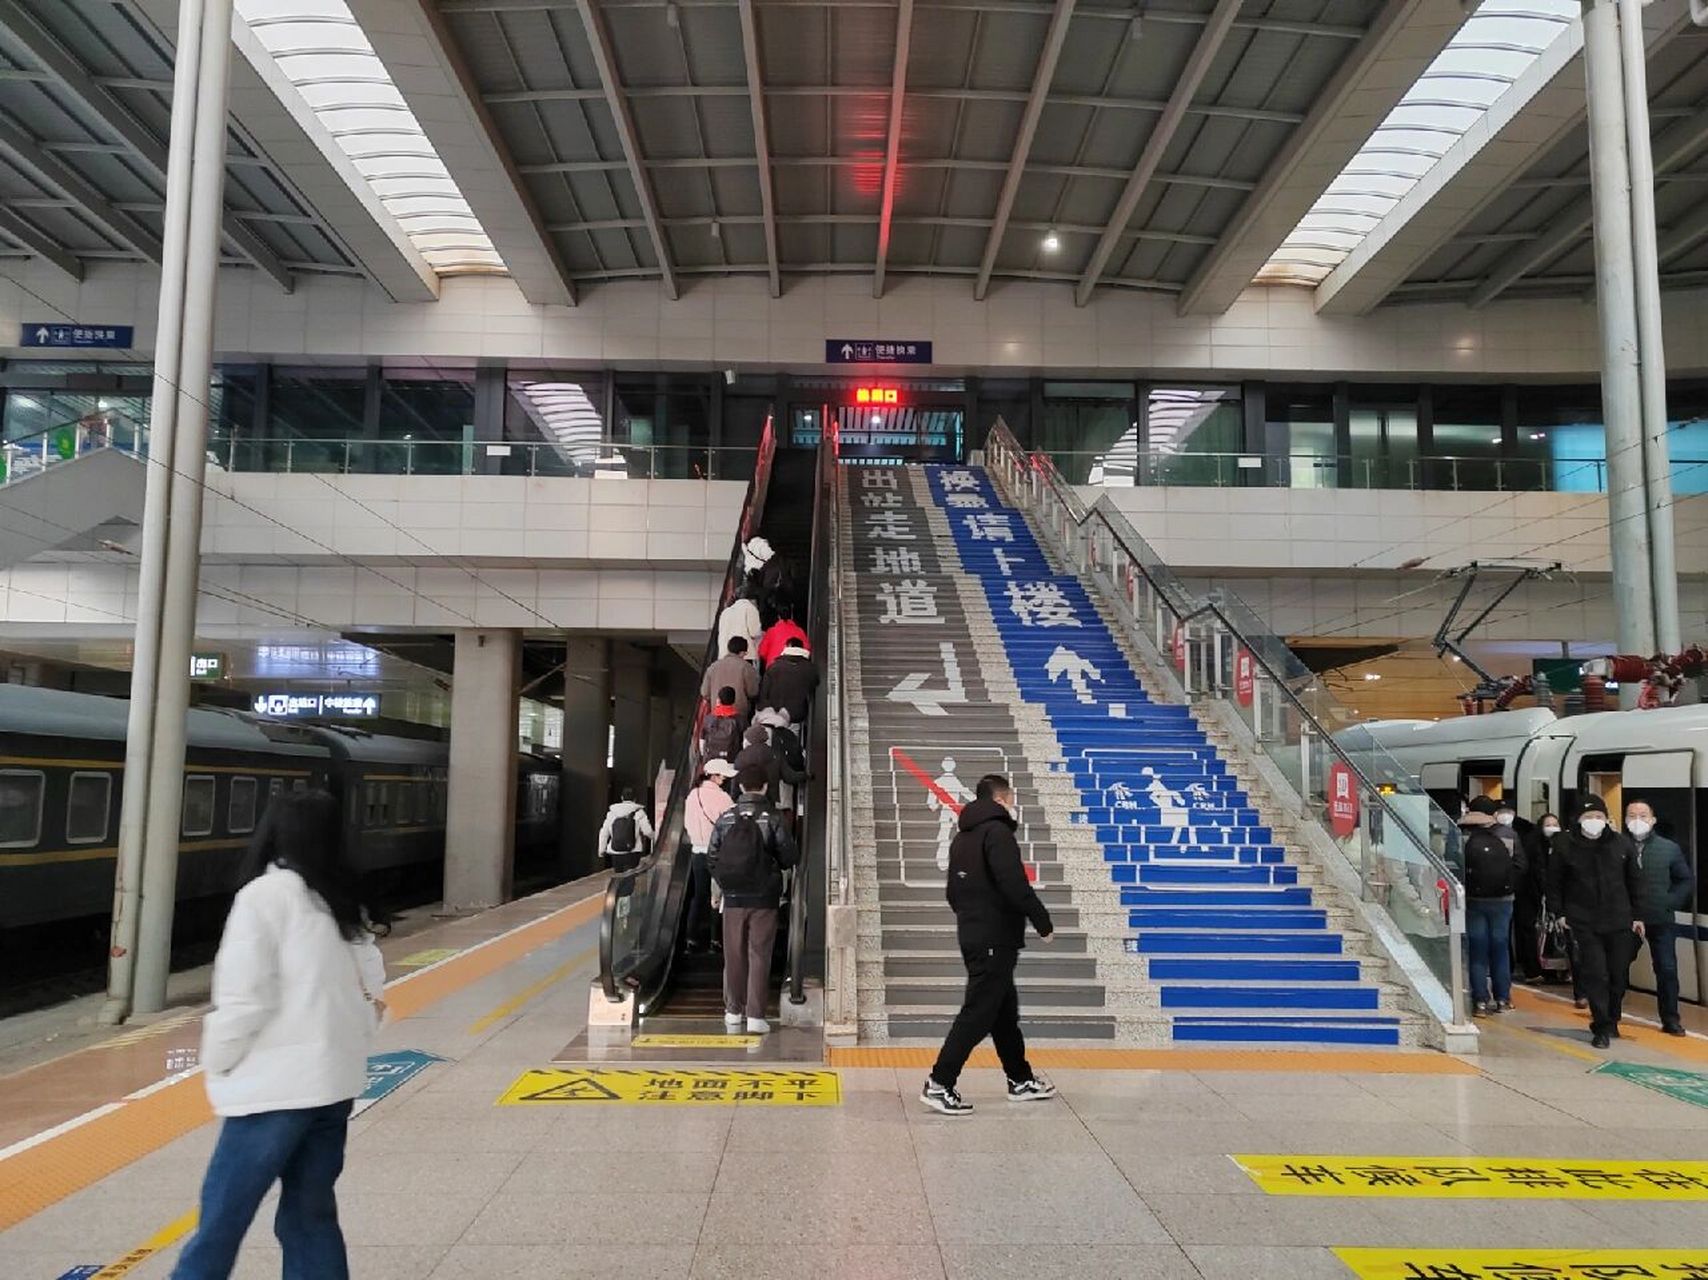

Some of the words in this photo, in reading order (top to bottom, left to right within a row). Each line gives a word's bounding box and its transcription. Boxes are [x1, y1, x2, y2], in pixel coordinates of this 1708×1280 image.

[646, 1078, 824, 1090] 地面不平
[639, 1090, 818, 1101] 注意脚下
